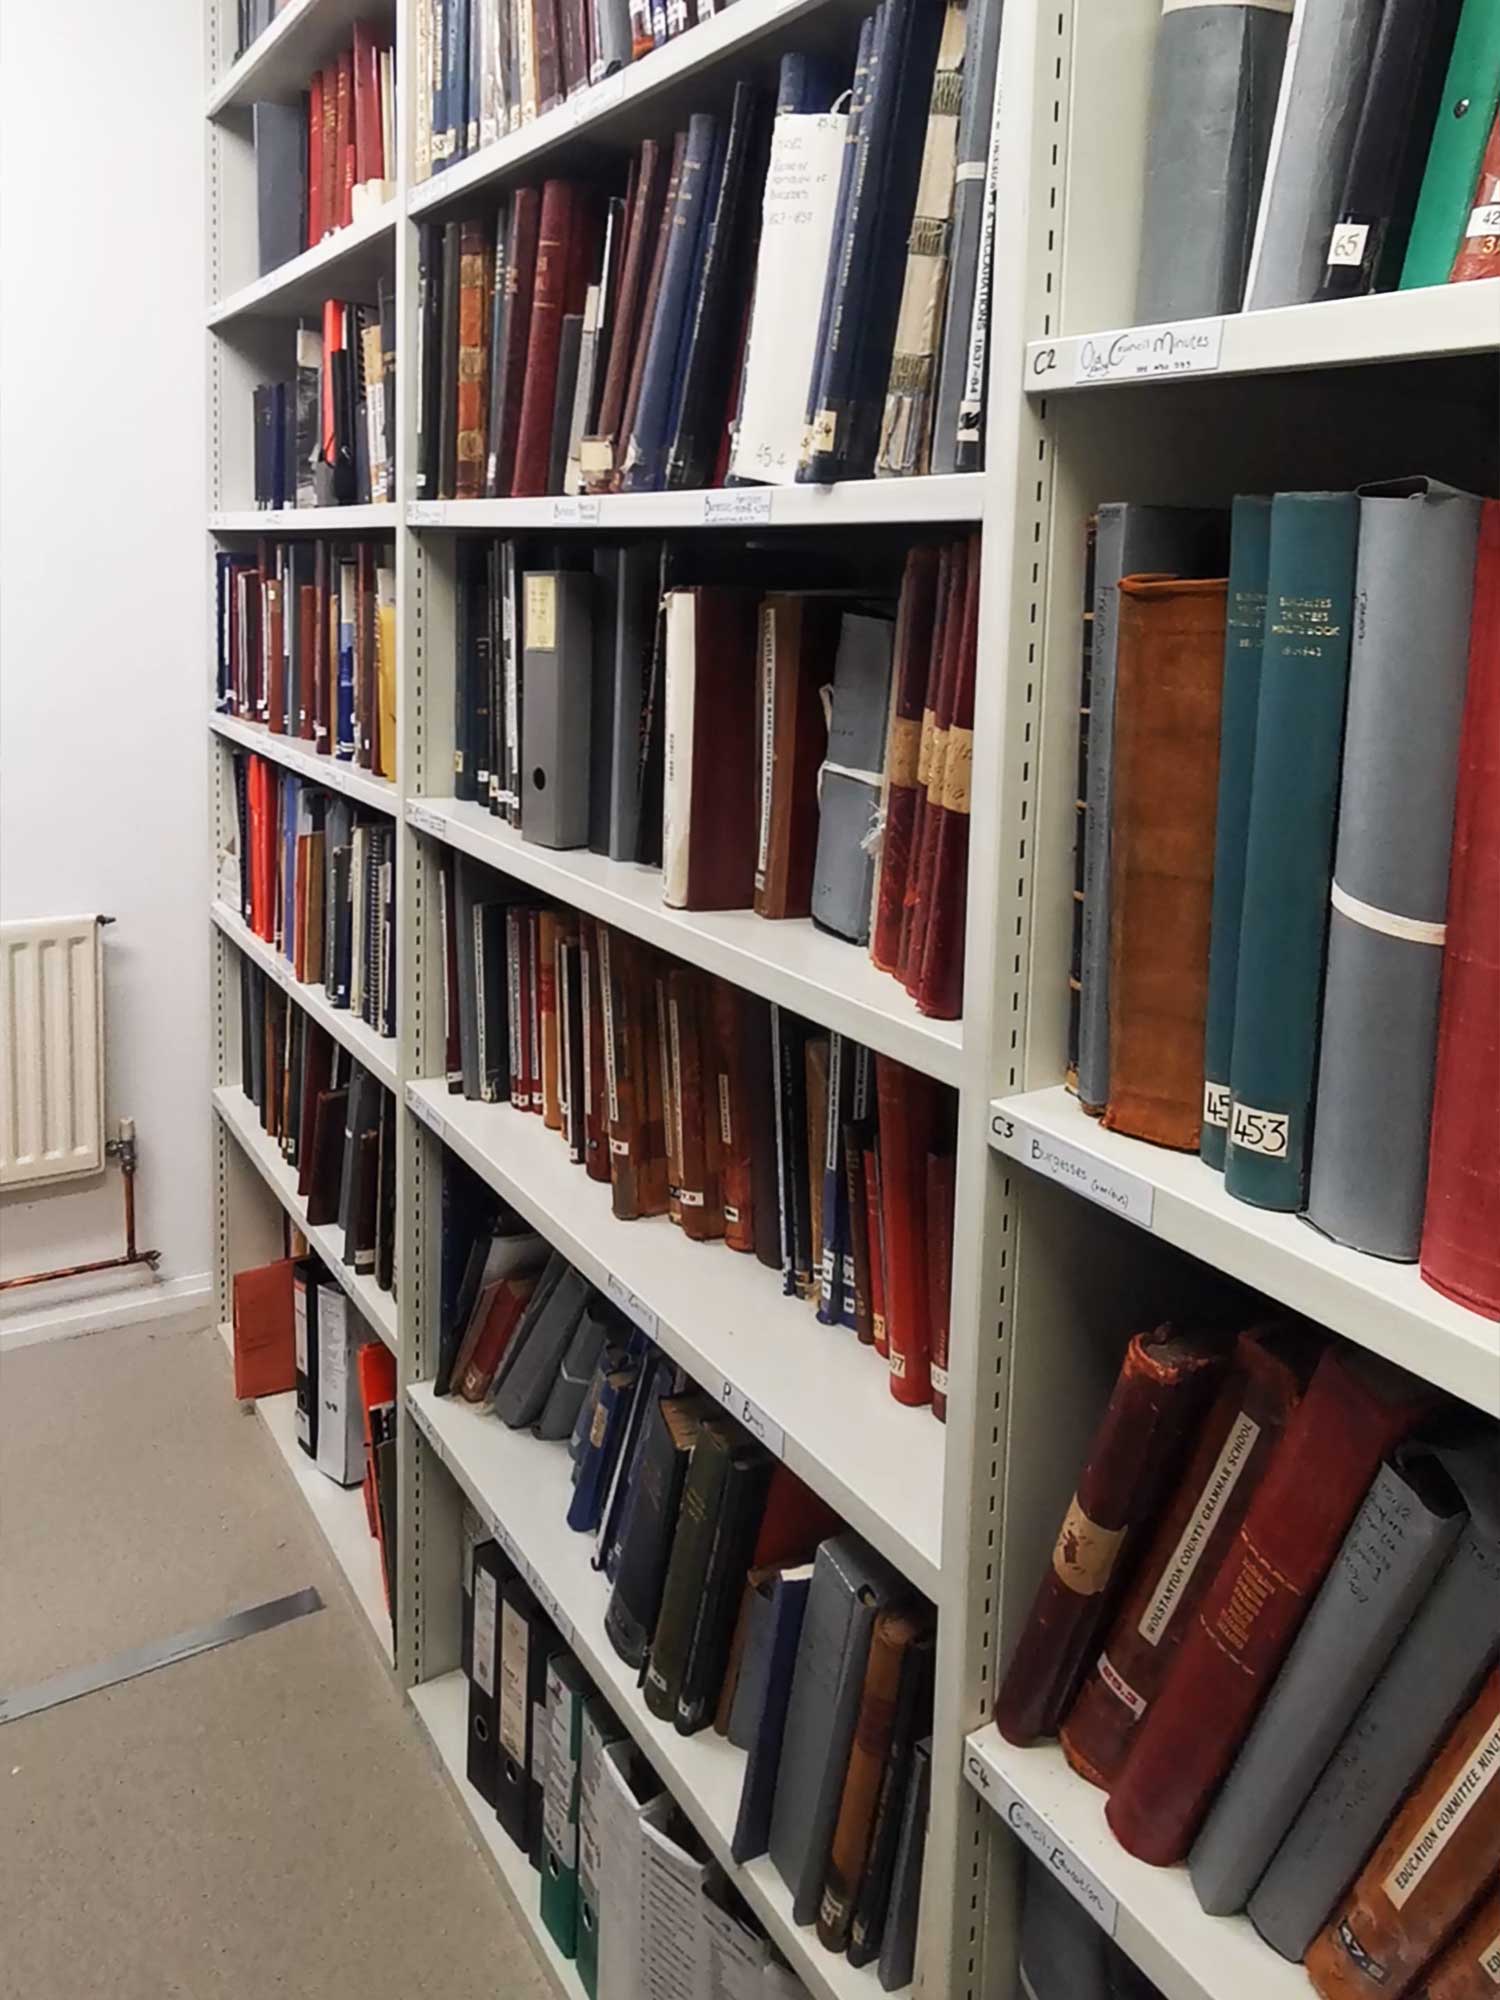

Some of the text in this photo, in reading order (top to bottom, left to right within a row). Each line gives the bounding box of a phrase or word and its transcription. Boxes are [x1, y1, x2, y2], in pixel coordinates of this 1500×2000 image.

[1334, 233, 1360, 257] 65
[1033, 349, 1056, 375] C2
[1108, 334, 1150, 366] Council
[992, 1116, 1014, 1138] C3
[1146, 1422, 1254, 1636] WOLSTANTON COUNTY GRAMMAR SCHOOL
[968, 1757, 991, 1789] C4
[1394, 1727, 1500, 1891] EDUCATION COMMITTEE MINUT
